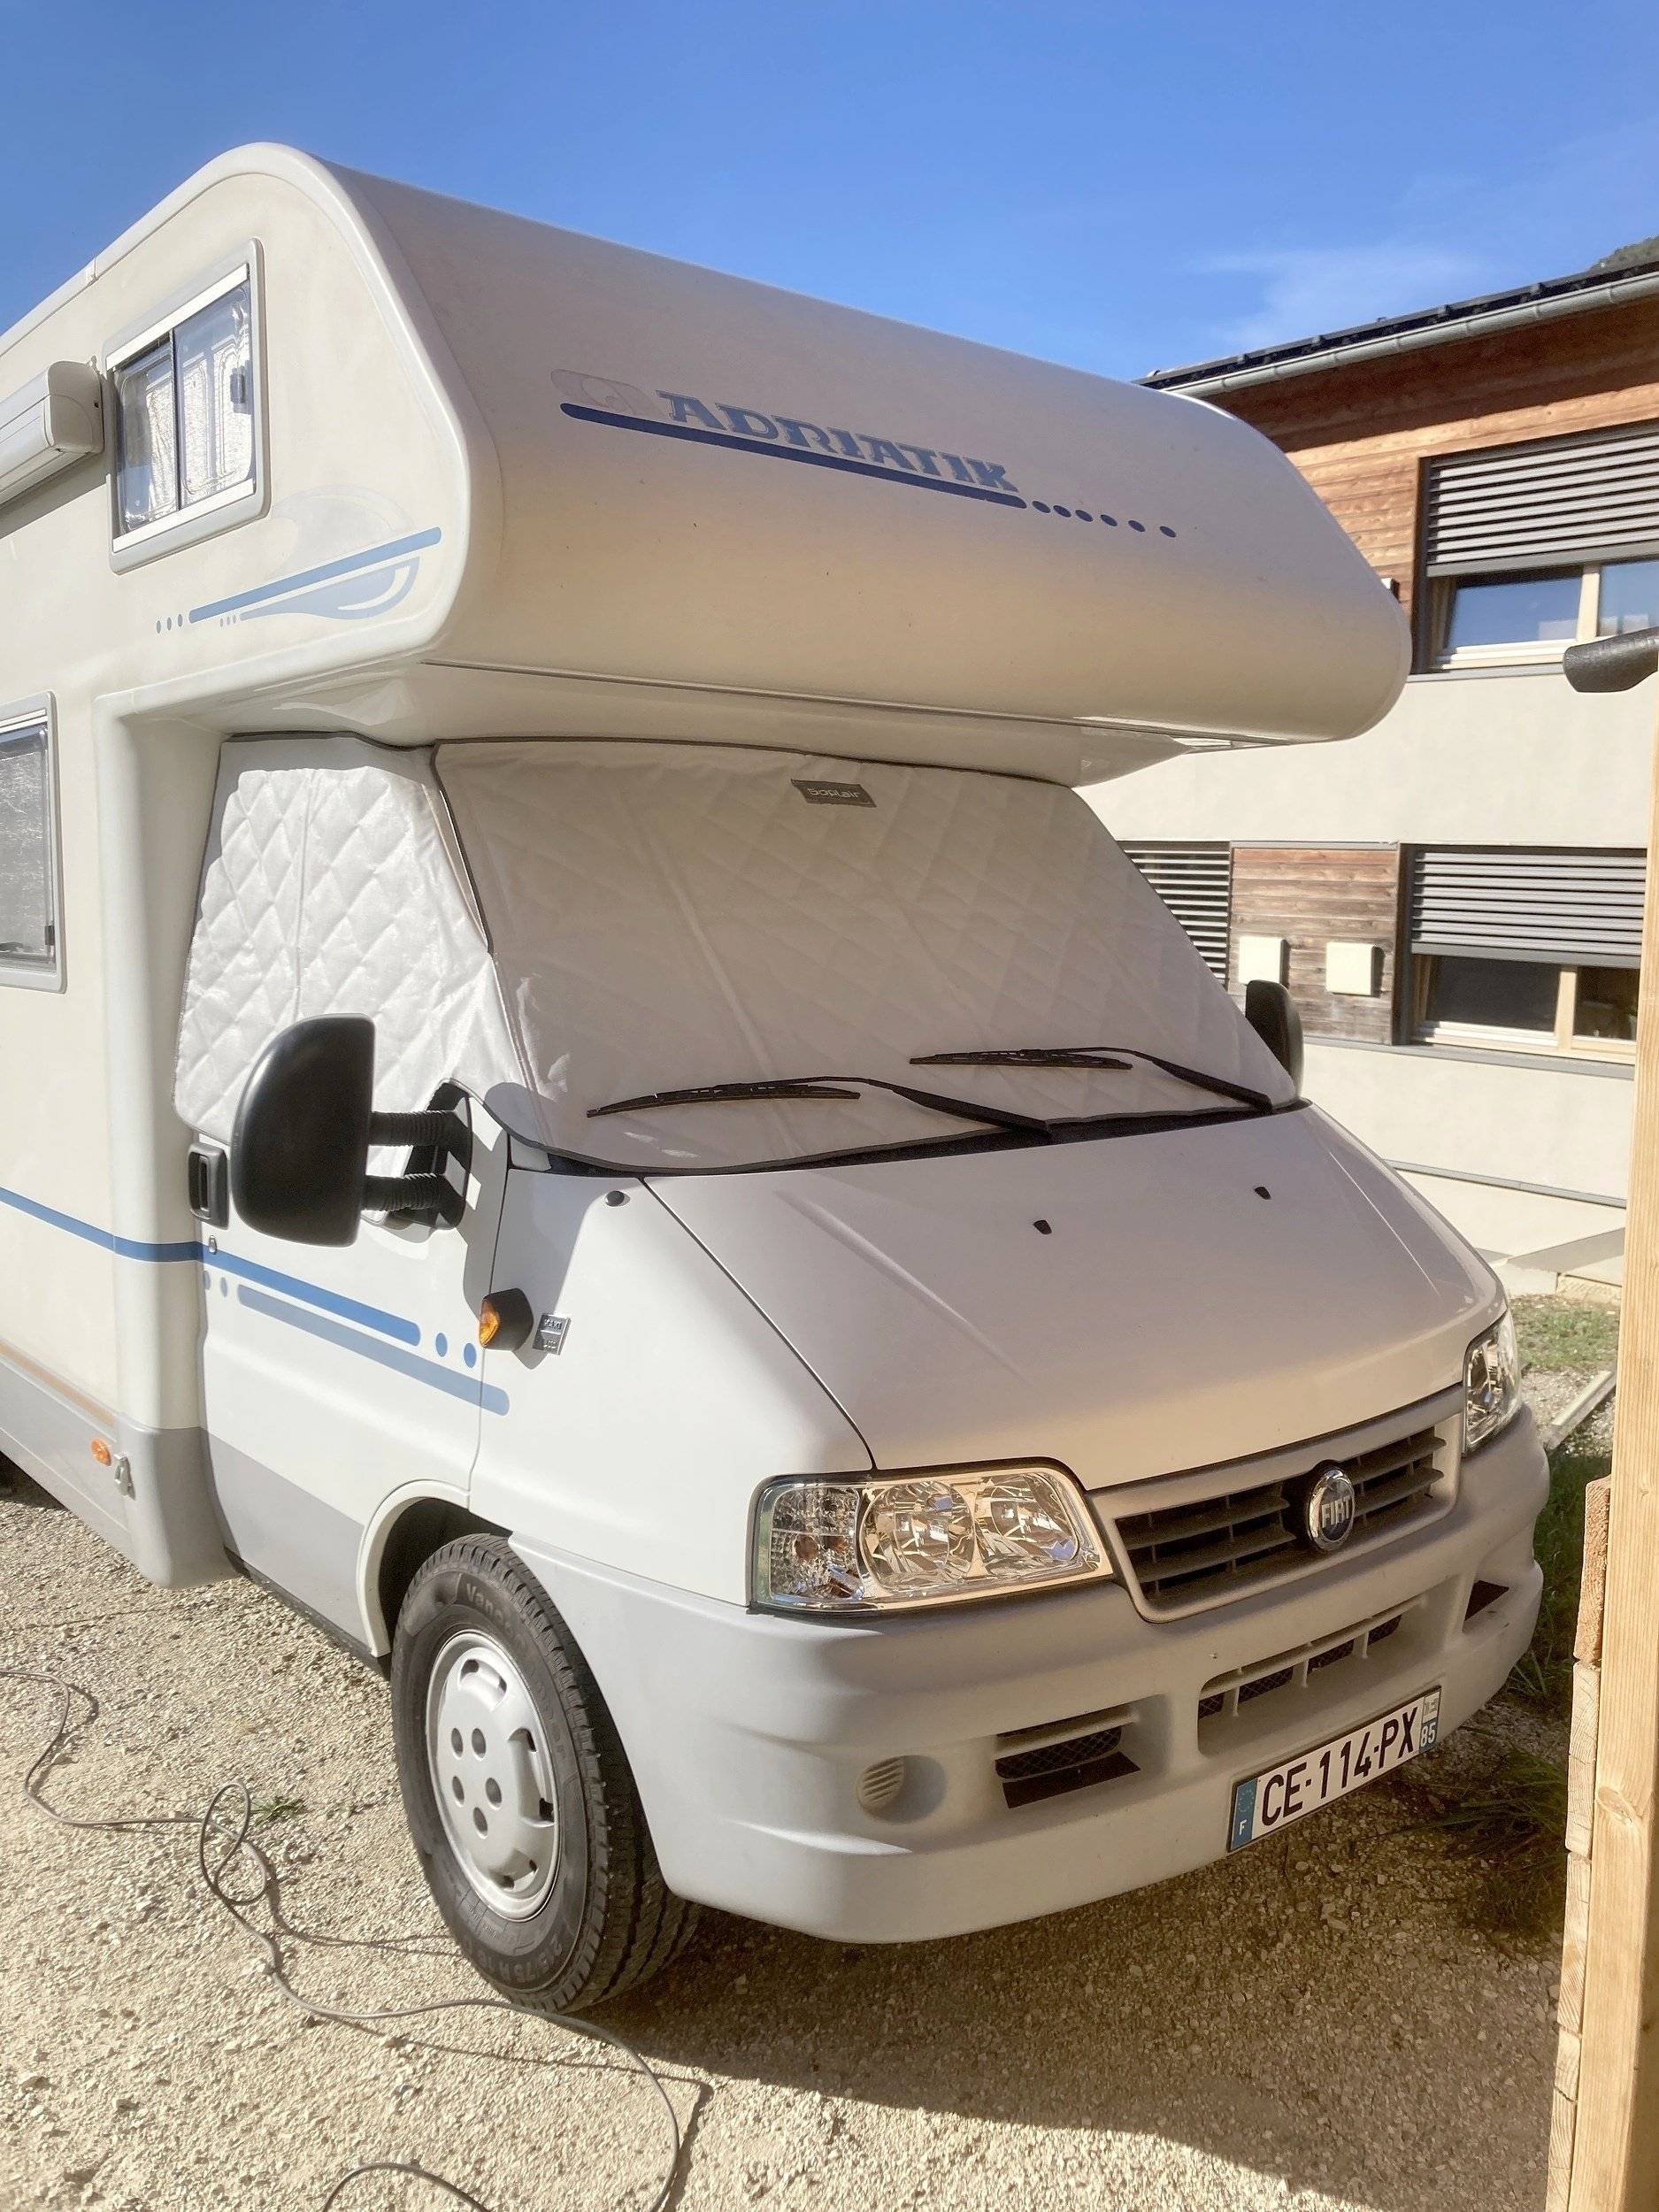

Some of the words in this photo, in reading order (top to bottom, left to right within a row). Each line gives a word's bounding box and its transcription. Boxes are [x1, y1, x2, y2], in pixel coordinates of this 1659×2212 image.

[656, 389, 1019, 492] ADRIATIK
[1321, 1495, 1351, 1529] FIAT
[1420, 1722, 1437, 1748] 85
[1262, 1706, 1418, 1826] CE-114-PX
[1239, 1819, 1248, 1836] F
